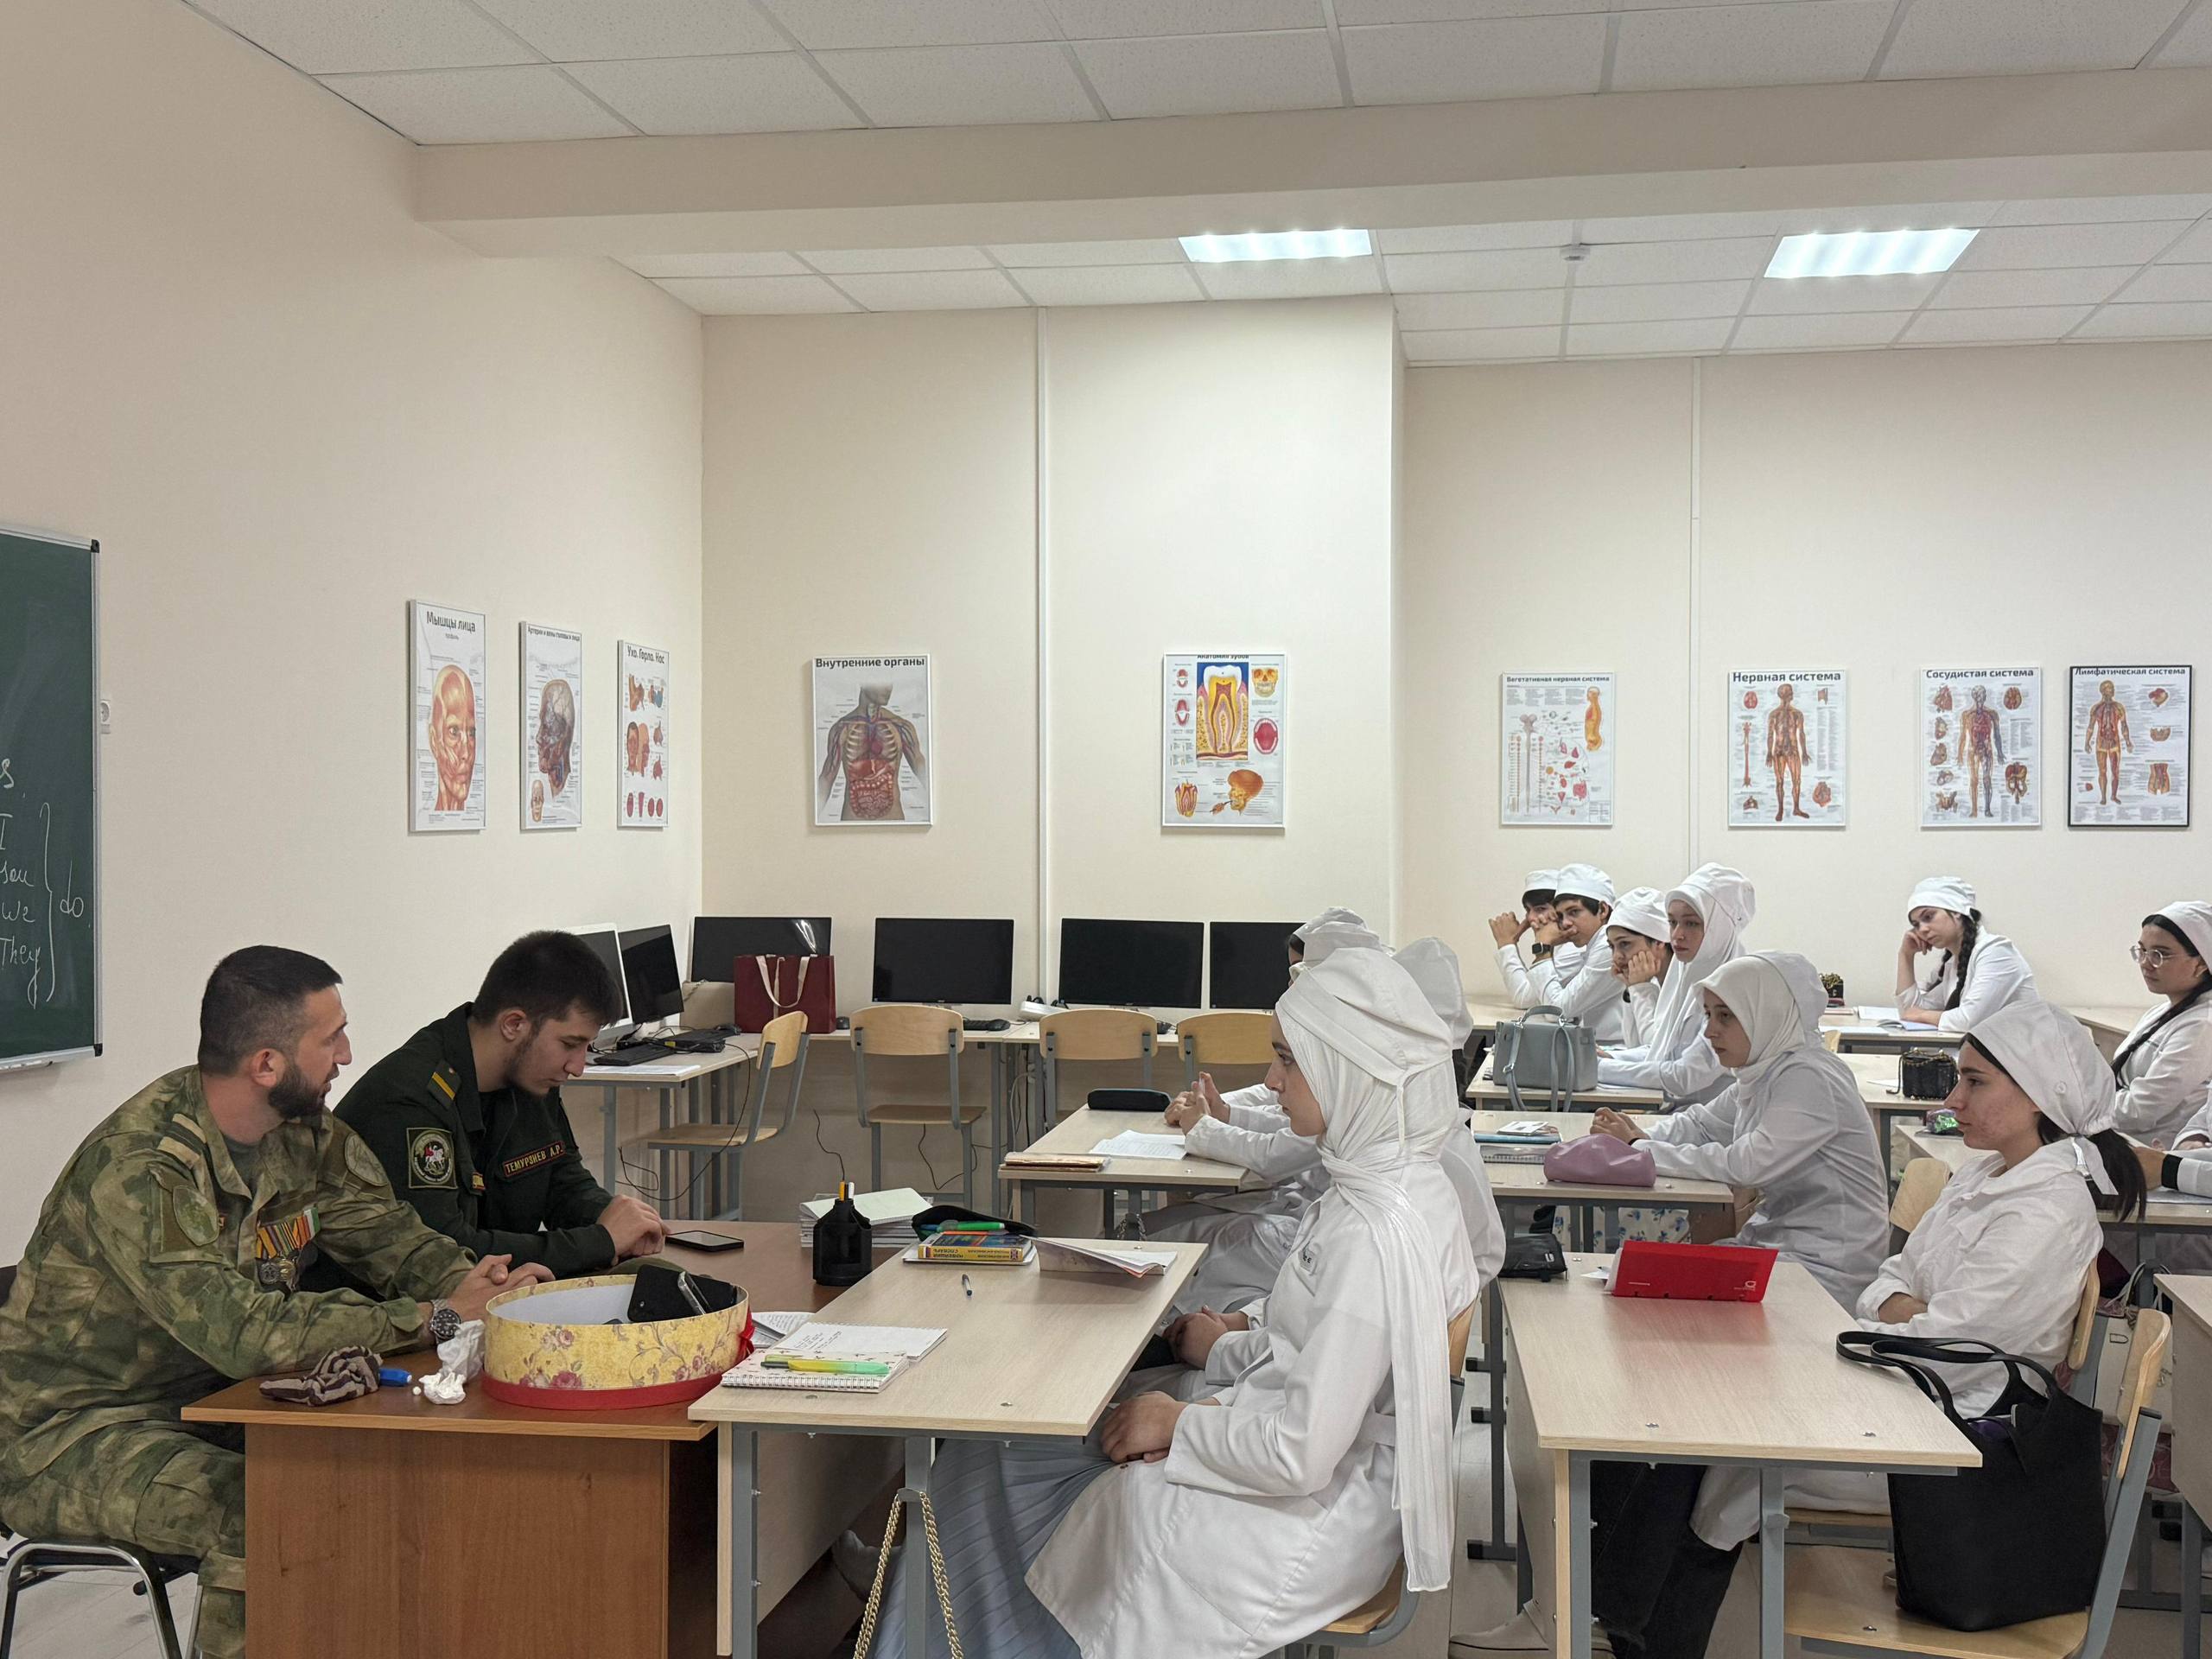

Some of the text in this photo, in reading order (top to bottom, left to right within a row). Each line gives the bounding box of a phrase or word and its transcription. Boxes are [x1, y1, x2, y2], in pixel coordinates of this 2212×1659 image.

[427, 611, 475, 633] Мышцы лица
[816, 658, 925, 669] Внутренние органы
[1732, 672, 1841, 683] Нервная система
[1926, 670, 1987, 680] Сосудистая
[2075, 668, 2146, 677] Лимфатическая
[505, 1144, 564, 1174] ТЕМУРЗИЕВ А.Р.
